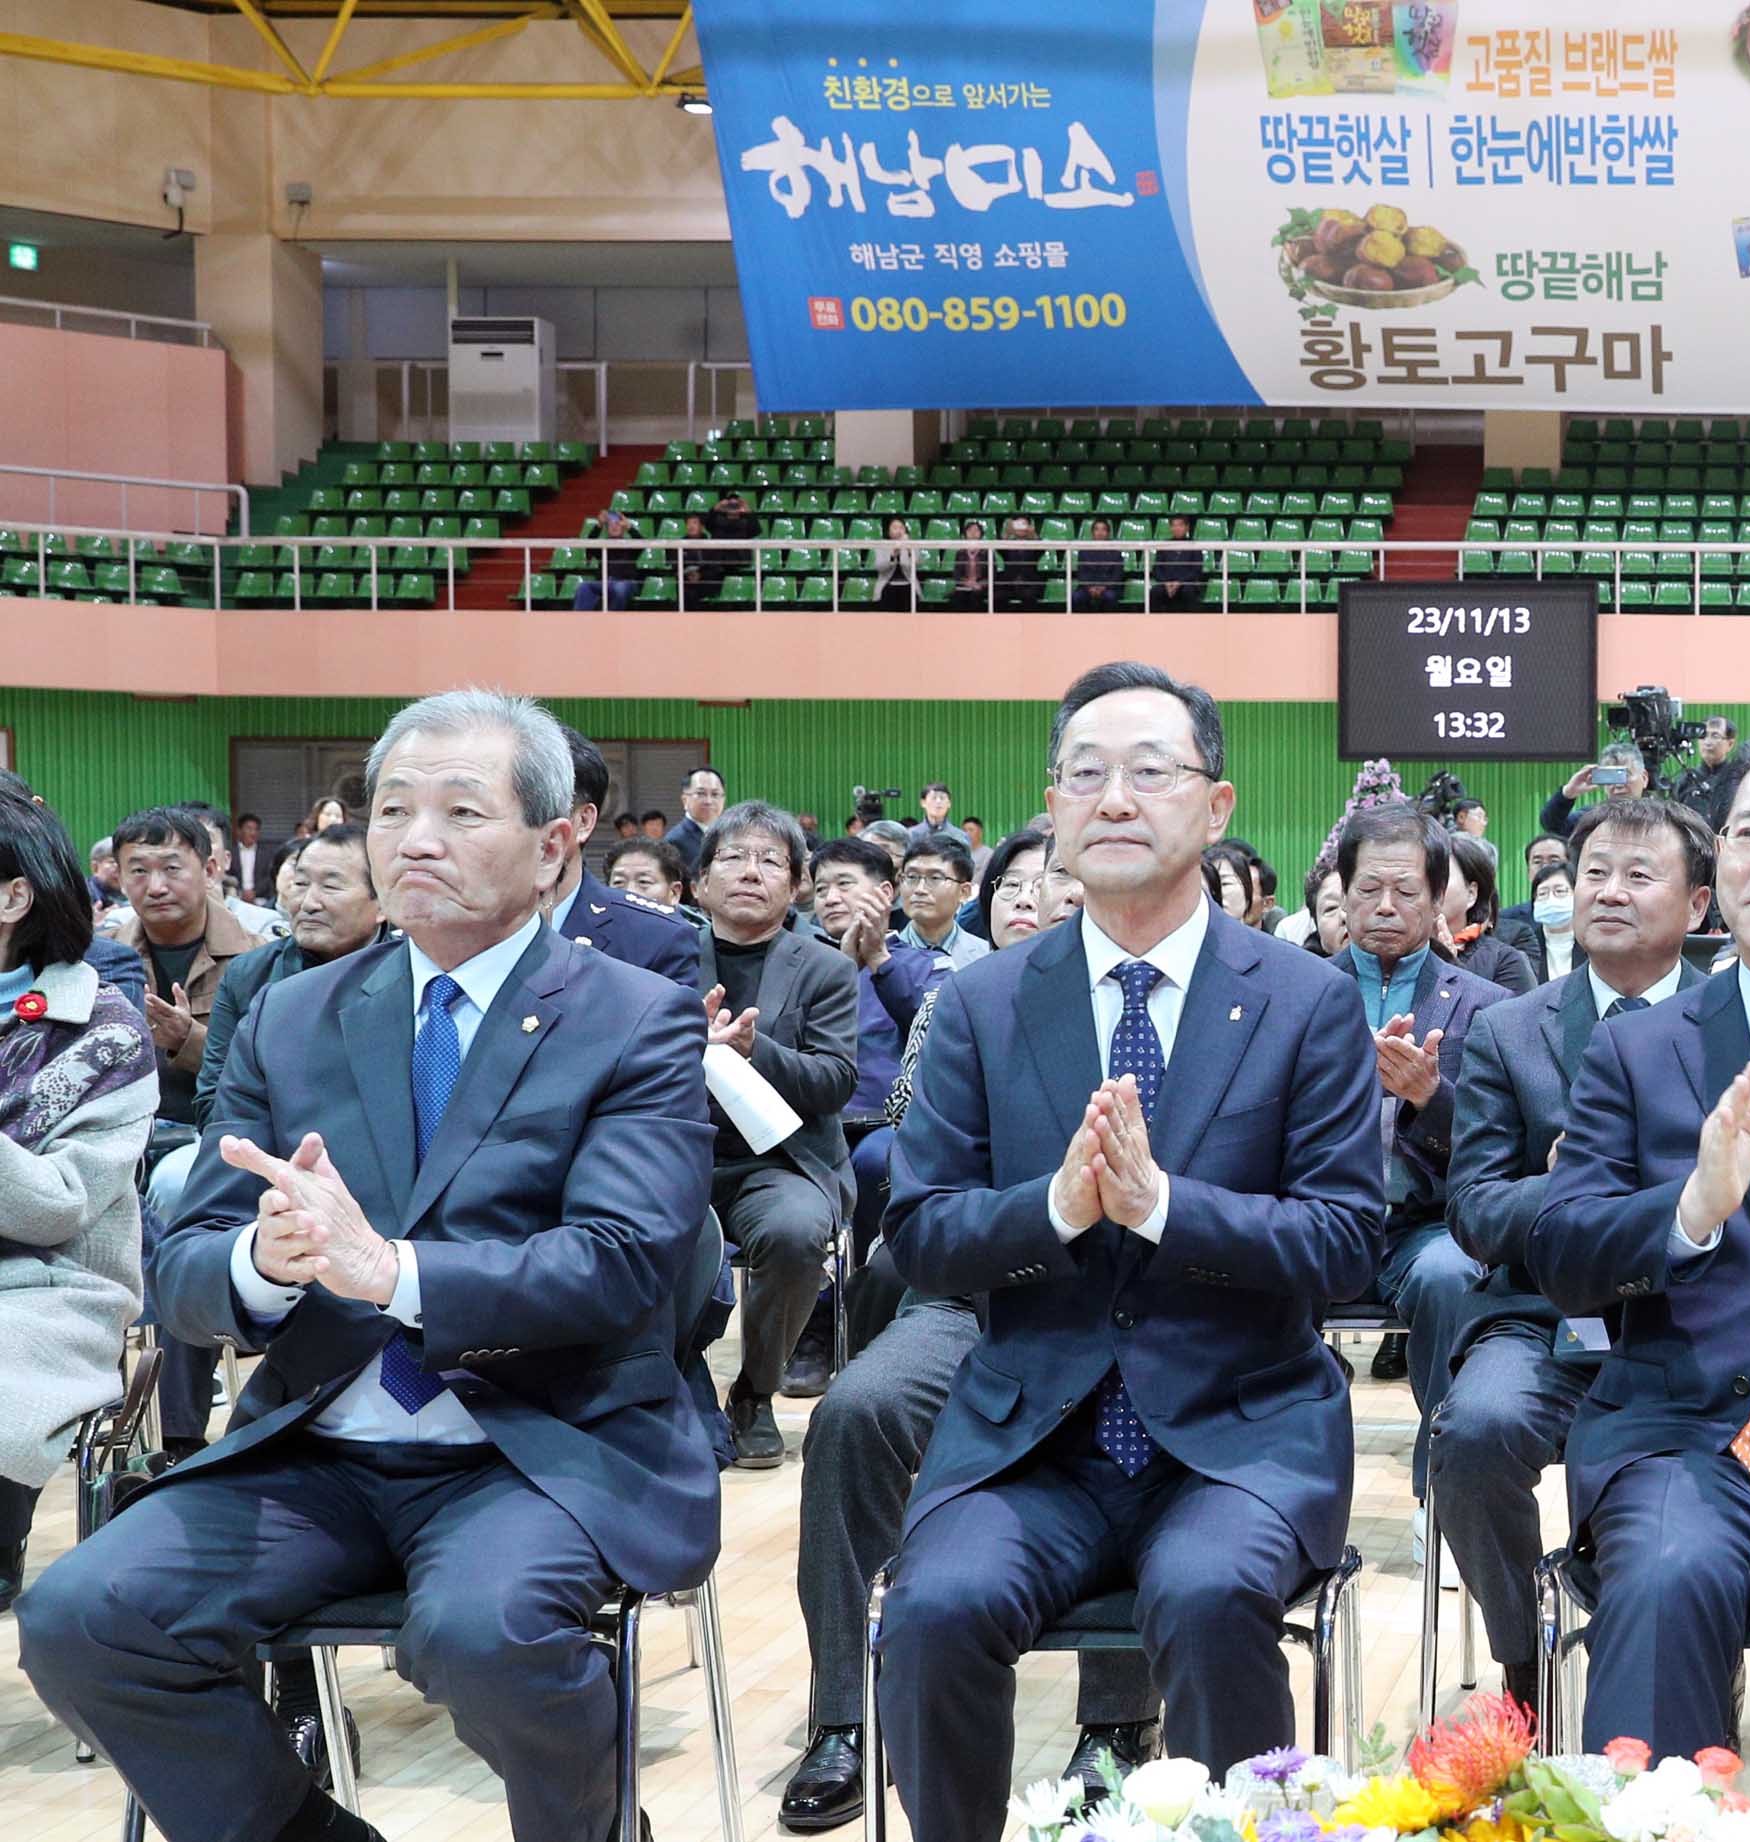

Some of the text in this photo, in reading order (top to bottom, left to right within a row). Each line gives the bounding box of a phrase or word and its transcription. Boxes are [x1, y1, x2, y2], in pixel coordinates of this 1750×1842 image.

[1465, 28, 1552, 98] 고품질
[1561, 29, 1678, 98] 브랜드쌀
[823, 75, 1051, 111] 친환경으로 앞서가는
[740, 115, 1135, 219] 해남미소
[1259, 113, 1678, 187] 땅끝햇살 한눈에반한쌀
[849, 241, 1069, 270] 해남군 직영 쇼핑몰
[1495, 249, 1669, 302] 땅끝해남
[850, 292, 1127, 332] 080-859-1100
[1299, 320, 1674, 395] 황토고구마
[1407, 606, 1531, 636] 23/11/13
[1424, 655, 1512, 688] 월요일
[1433, 711, 1506, 739] 13:32
